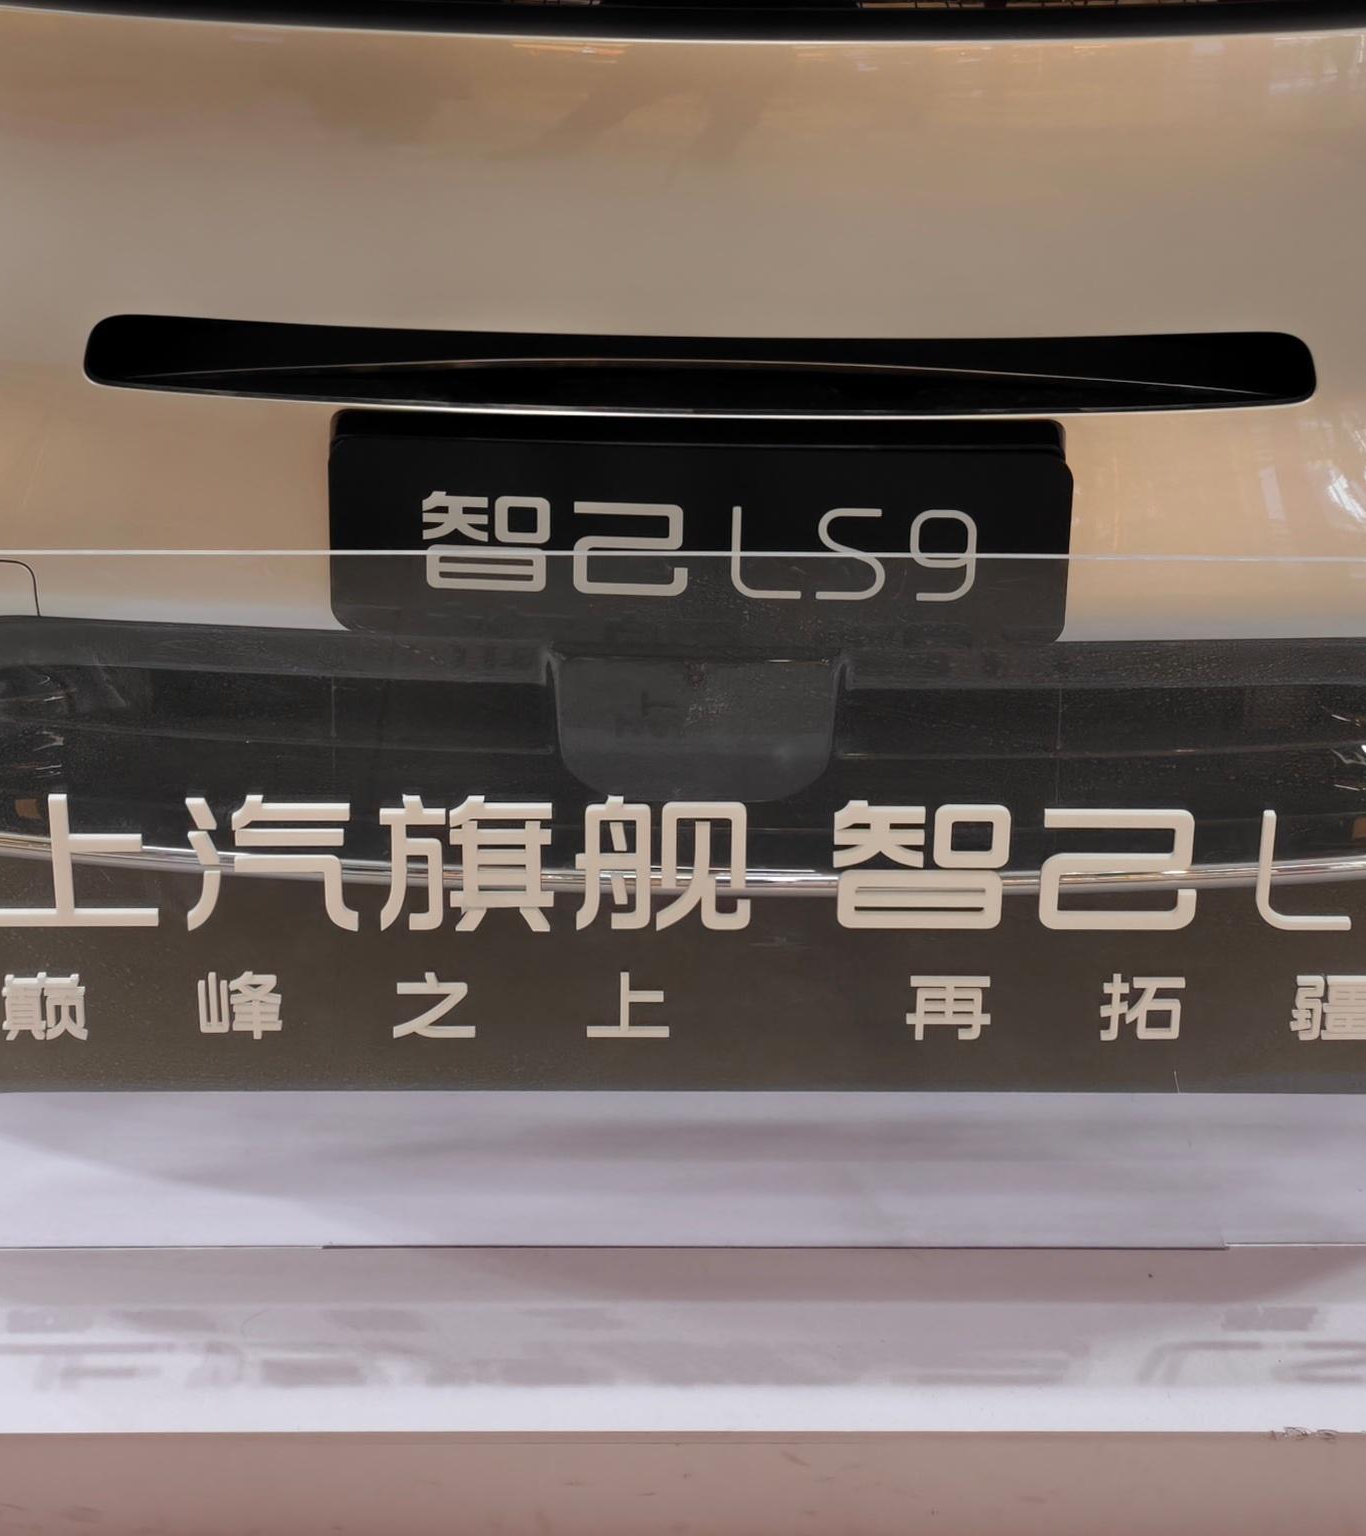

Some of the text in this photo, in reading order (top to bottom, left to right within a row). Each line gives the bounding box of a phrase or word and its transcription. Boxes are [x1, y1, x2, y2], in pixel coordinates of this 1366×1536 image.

[422, 490, 982, 602] 智己LS9
[2, 971, 671, 1041] 巅峰之上
